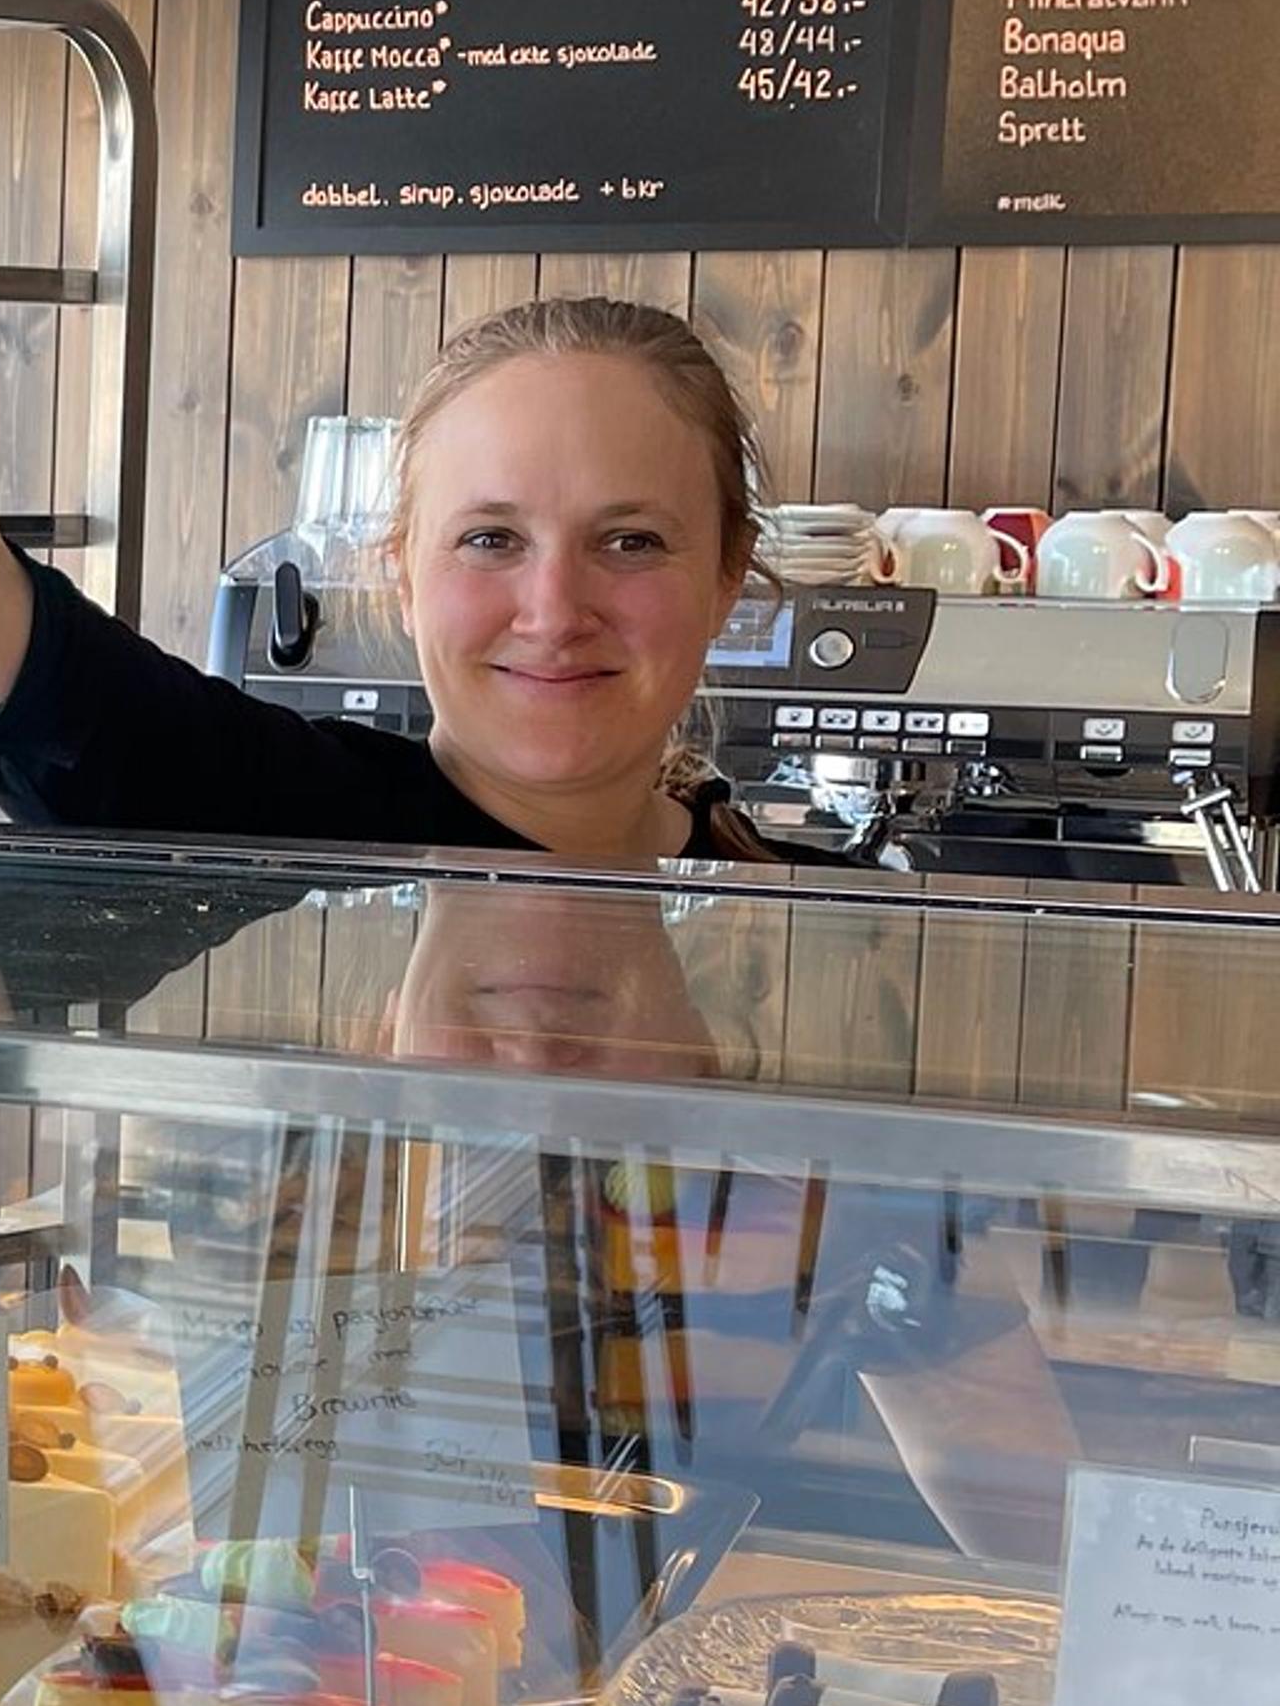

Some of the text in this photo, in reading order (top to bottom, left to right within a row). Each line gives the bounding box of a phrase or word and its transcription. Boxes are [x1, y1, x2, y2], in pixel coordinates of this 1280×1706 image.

[305, 40, 365, 73] Kaffe
[557, 40, 658, 70] sjokolade
[1003, 17, 1127, 64] Bonaqua
[303, 80, 362, 112] Kaffe
[998, 64, 1128, 100] Balholm
[997, 110, 1087, 149] Sprett
[469, 178, 581, 211] sjokolade
